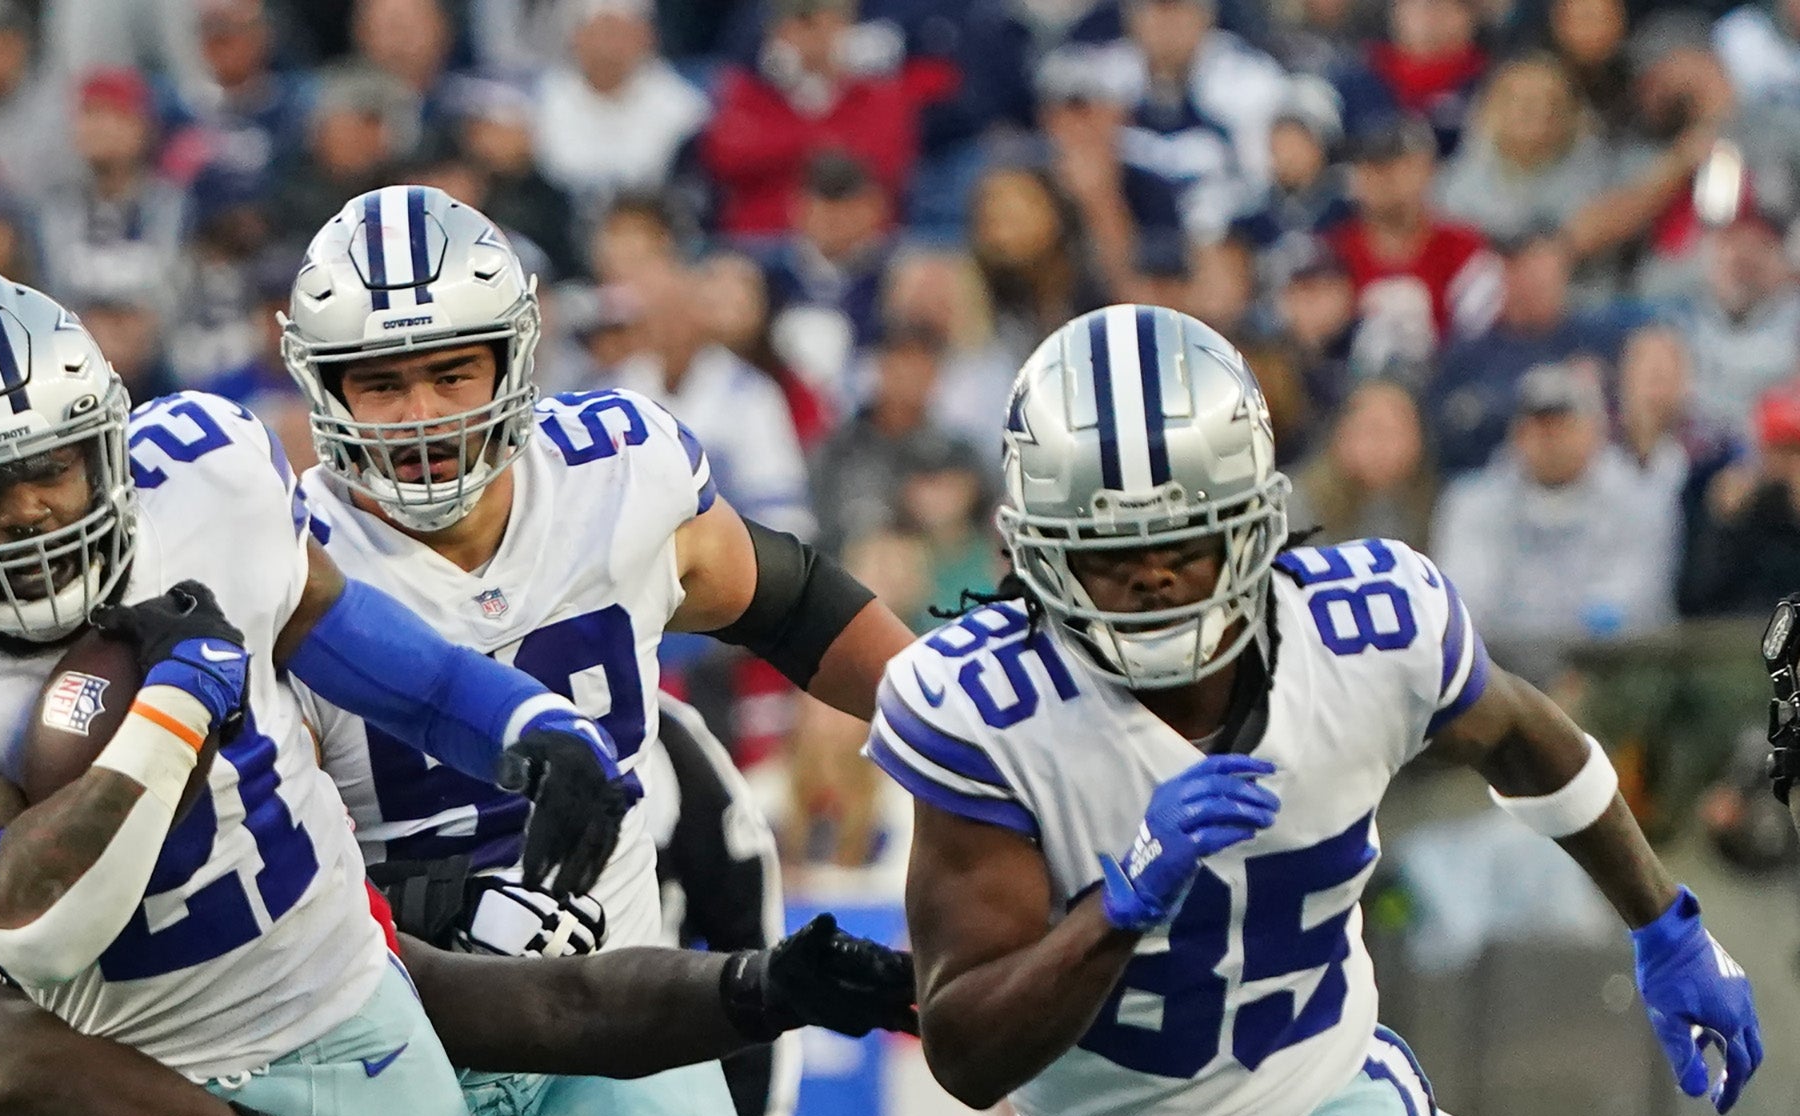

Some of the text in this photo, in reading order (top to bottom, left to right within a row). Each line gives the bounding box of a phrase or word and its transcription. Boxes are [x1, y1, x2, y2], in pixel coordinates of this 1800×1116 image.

[382, 315, 434, 330] COWBOYS
[1274, 537, 1418, 657] 85
[48, 677, 84, 718] NFL
[924, 601, 1082, 731] 85
[1066, 806, 1379, 1080] 85
